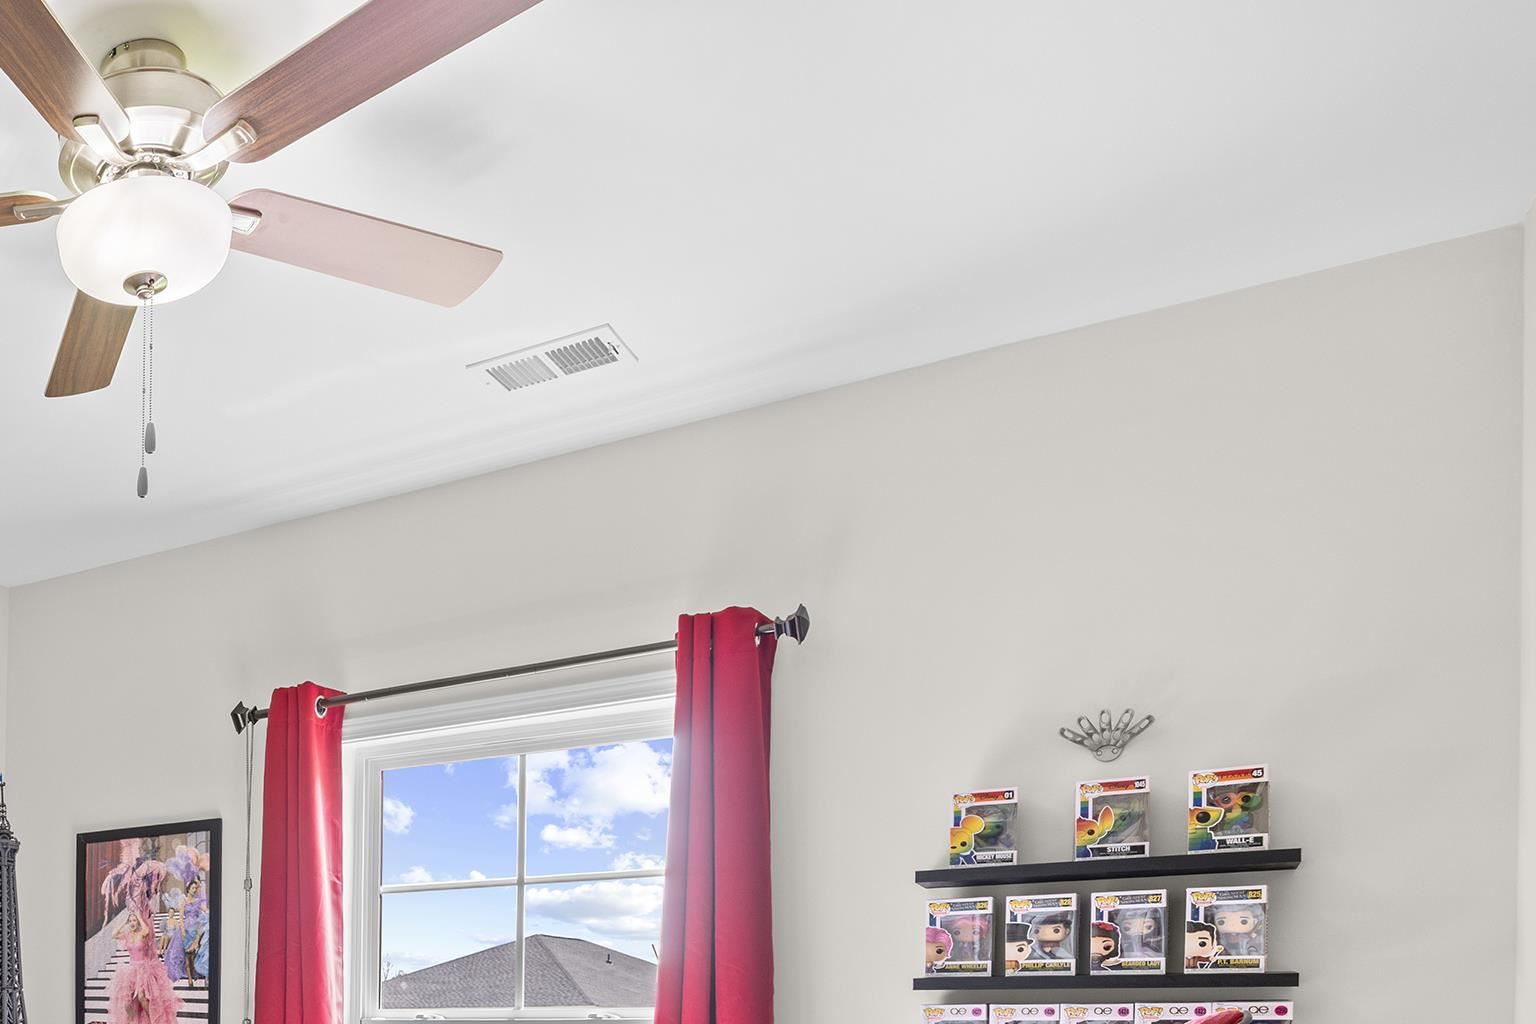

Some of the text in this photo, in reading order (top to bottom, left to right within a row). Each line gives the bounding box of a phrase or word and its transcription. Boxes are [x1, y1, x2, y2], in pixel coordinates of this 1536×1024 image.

[1004, 791, 1013, 799] 01
[1226, 837, 1254, 845] WALL-E
[1107, 845, 1131, 853] STITCH
[1095, 897, 1119, 908] POP!
[1191, 892, 1216, 904] POP!
[929, 902, 951, 913] POP!
[1009, 900, 1032, 911] POP!
[924, 1008, 945, 1017] POP!
[994, 1007, 1016, 1017] POP!
[1064, 1007, 1088, 1017] POP!
[1137, 1006, 1164, 1018] POP!
